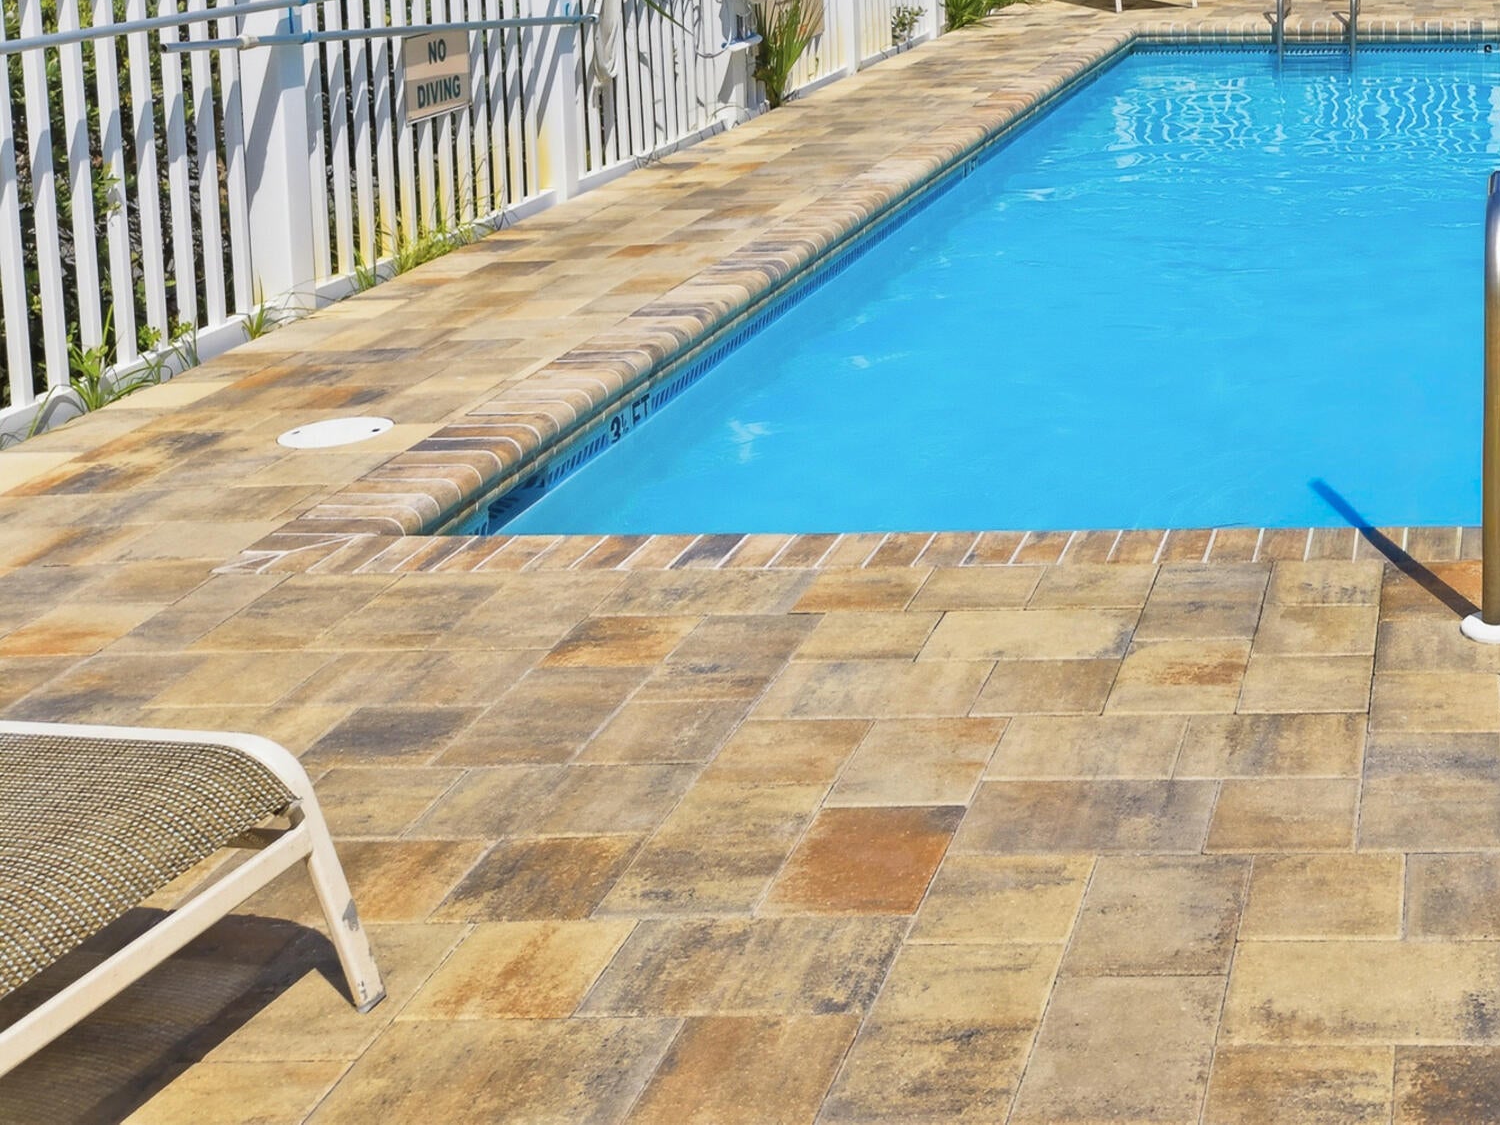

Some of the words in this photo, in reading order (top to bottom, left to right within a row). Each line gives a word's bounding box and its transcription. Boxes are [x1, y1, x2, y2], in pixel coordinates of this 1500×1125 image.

[428, 39, 447, 64] NO
[417, 75, 461, 109] DIVING
[632, 393, 650, 426] FT
